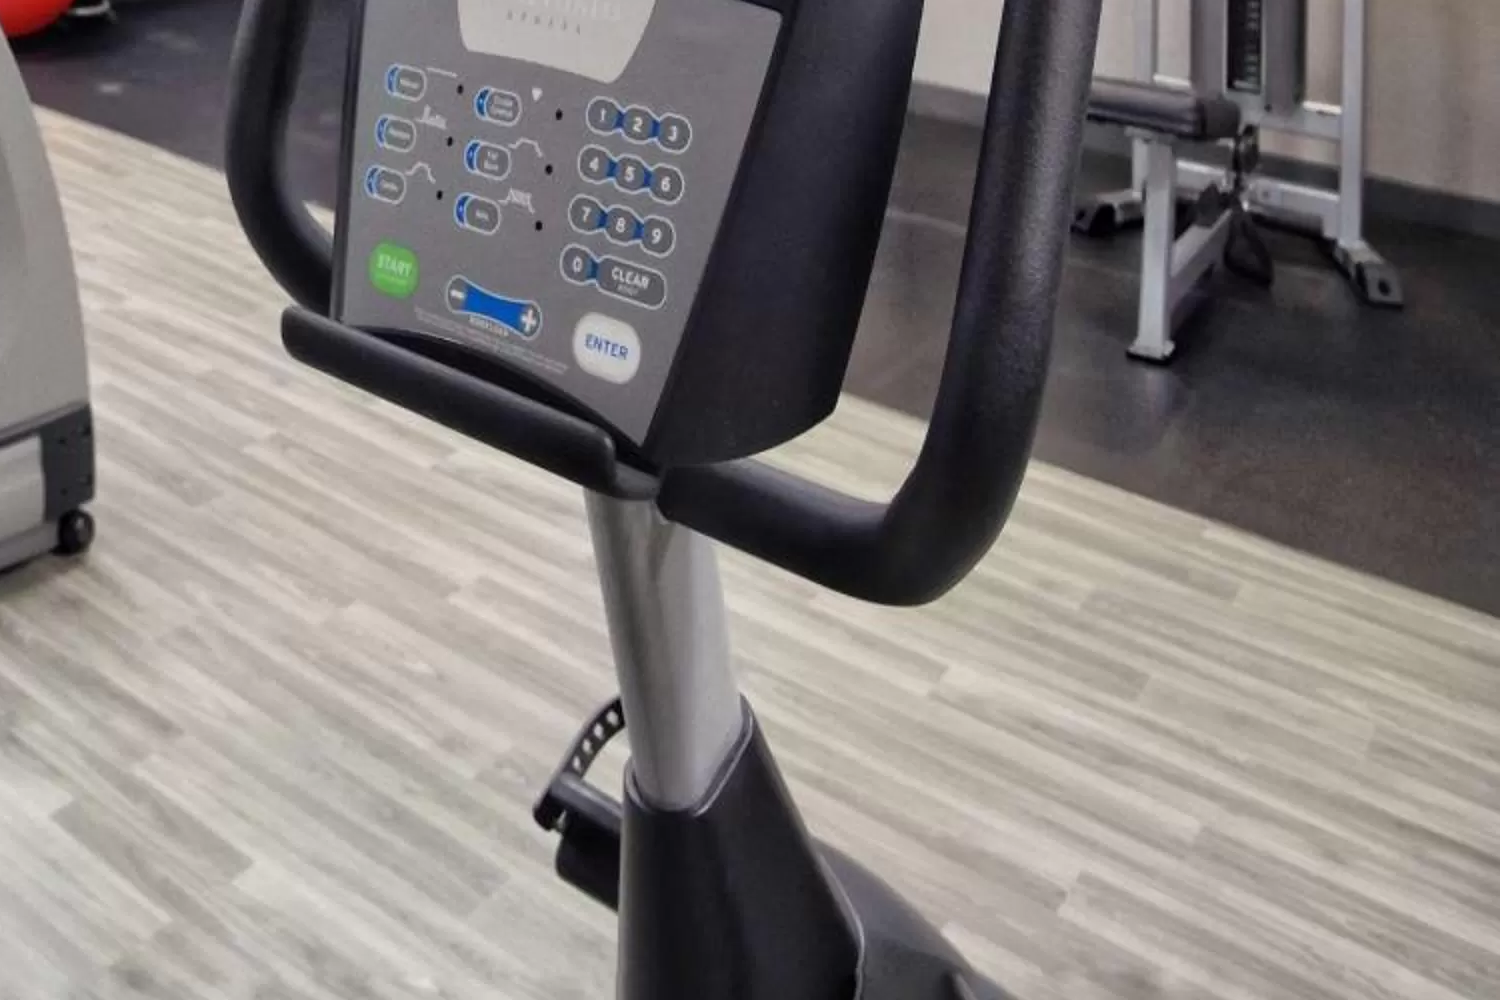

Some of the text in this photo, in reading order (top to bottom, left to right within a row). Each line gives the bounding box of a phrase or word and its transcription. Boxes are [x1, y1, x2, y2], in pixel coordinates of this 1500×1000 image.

[632, 116, 643, 133] 2
[667, 125, 678, 142] 3
[589, 156, 671, 193] 4 5 6
[582, 206, 662, 245] 7 8 9
[378, 253, 413, 278] START
[573, 255, 583, 273] 0
[611, 265, 651, 290] CLEAR
[585, 333, 629, 361] ENTER
